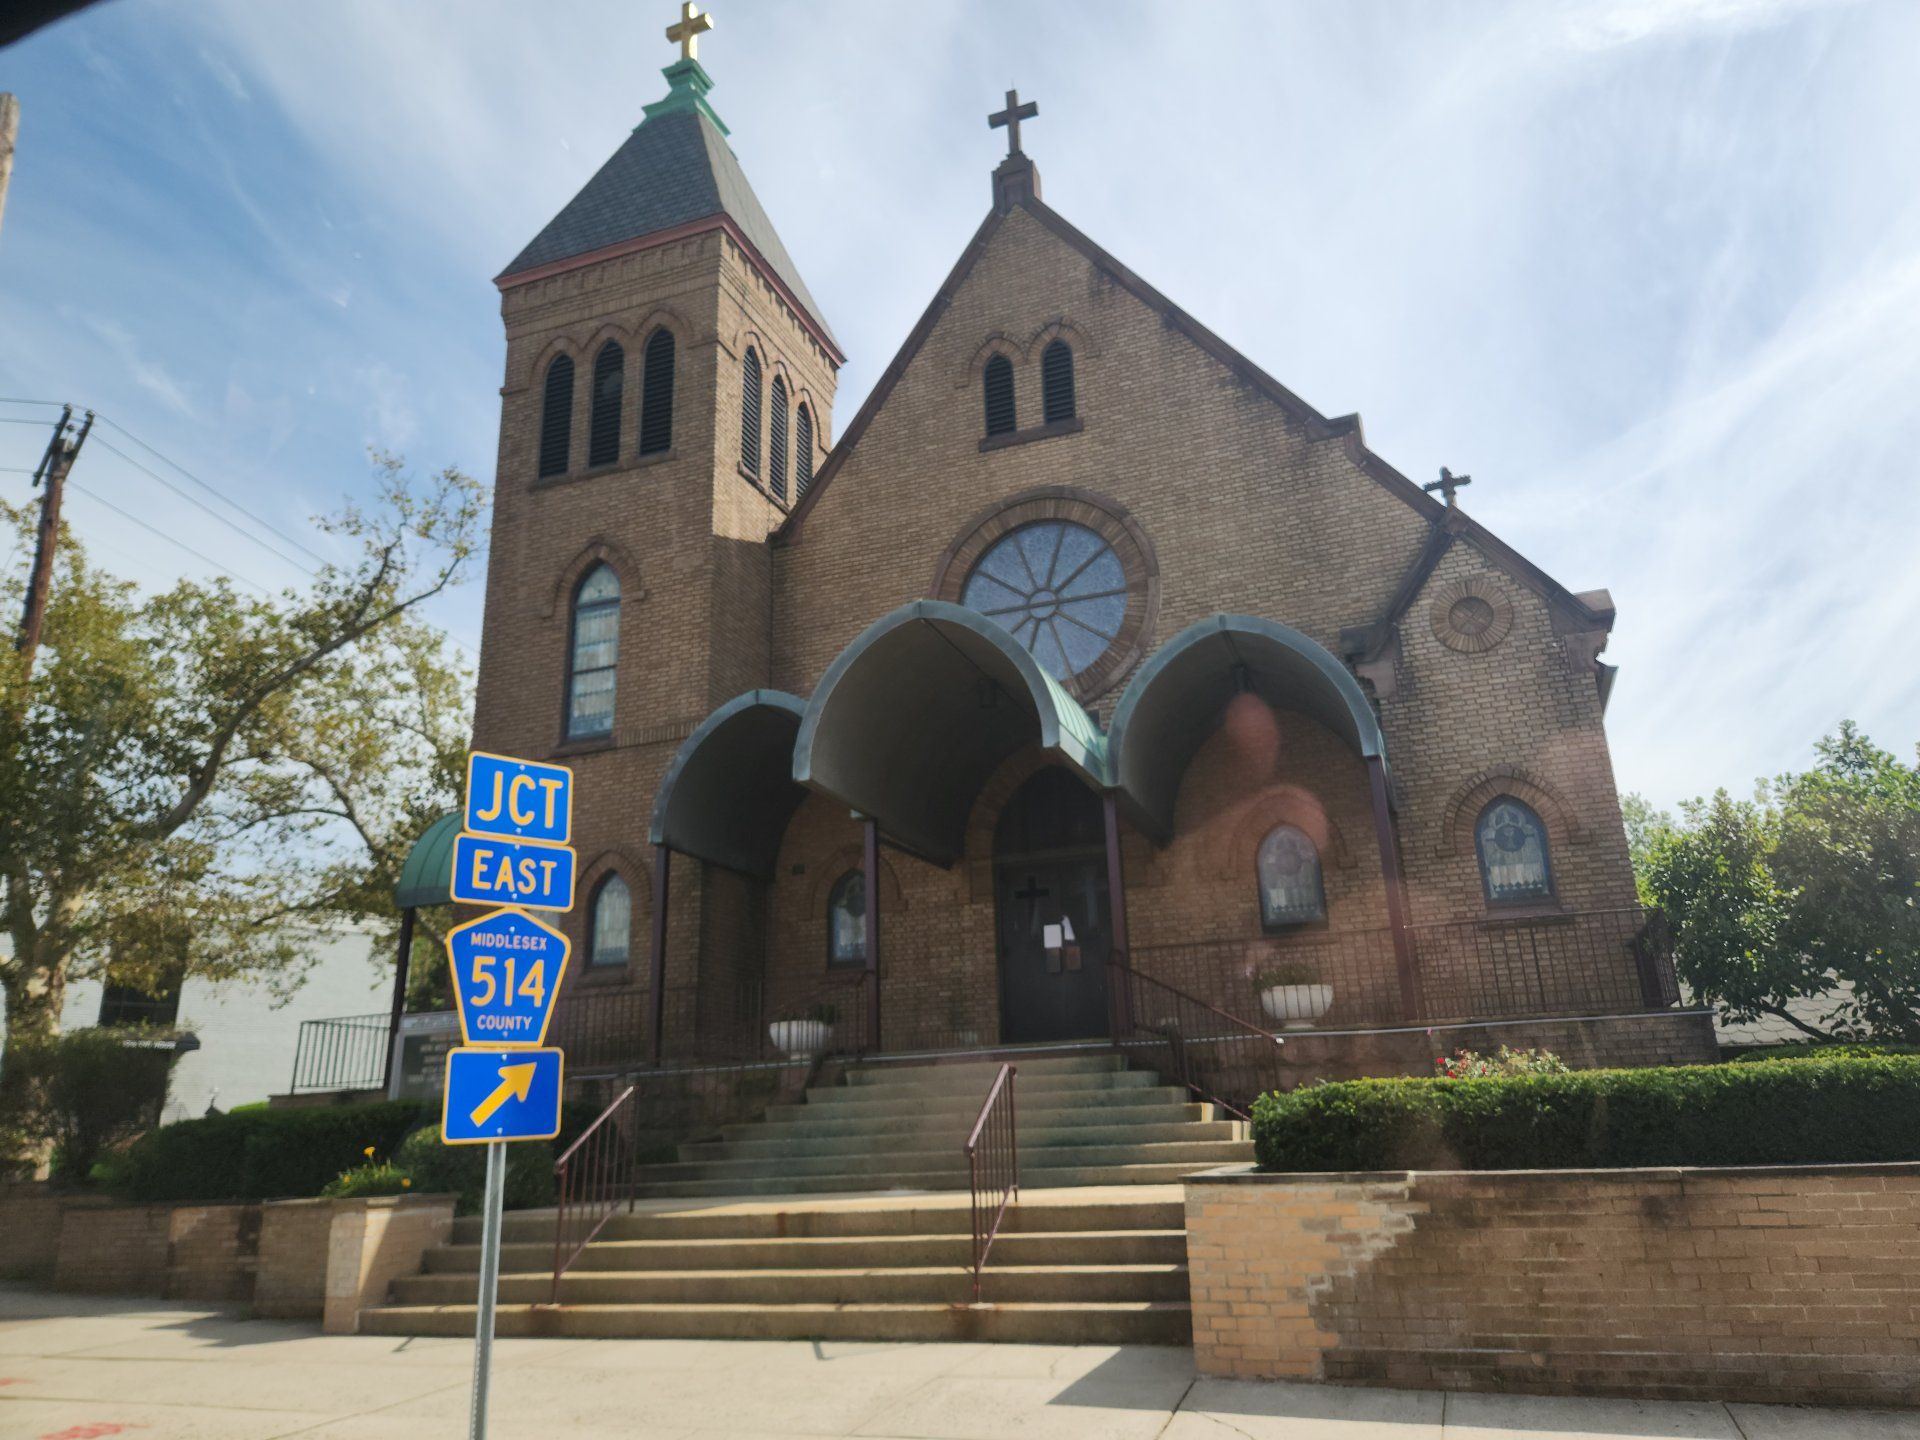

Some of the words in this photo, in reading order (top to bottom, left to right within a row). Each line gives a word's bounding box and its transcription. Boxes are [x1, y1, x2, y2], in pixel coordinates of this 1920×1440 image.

[476, 771, 563, 829] JCT
[472, 849, 557, 896] EAST
[470, 932, 547, 951] MIDDLESEX
[470, 955, 545, 1007] 514
[477, 1014, 532, 1031] COUNTY
